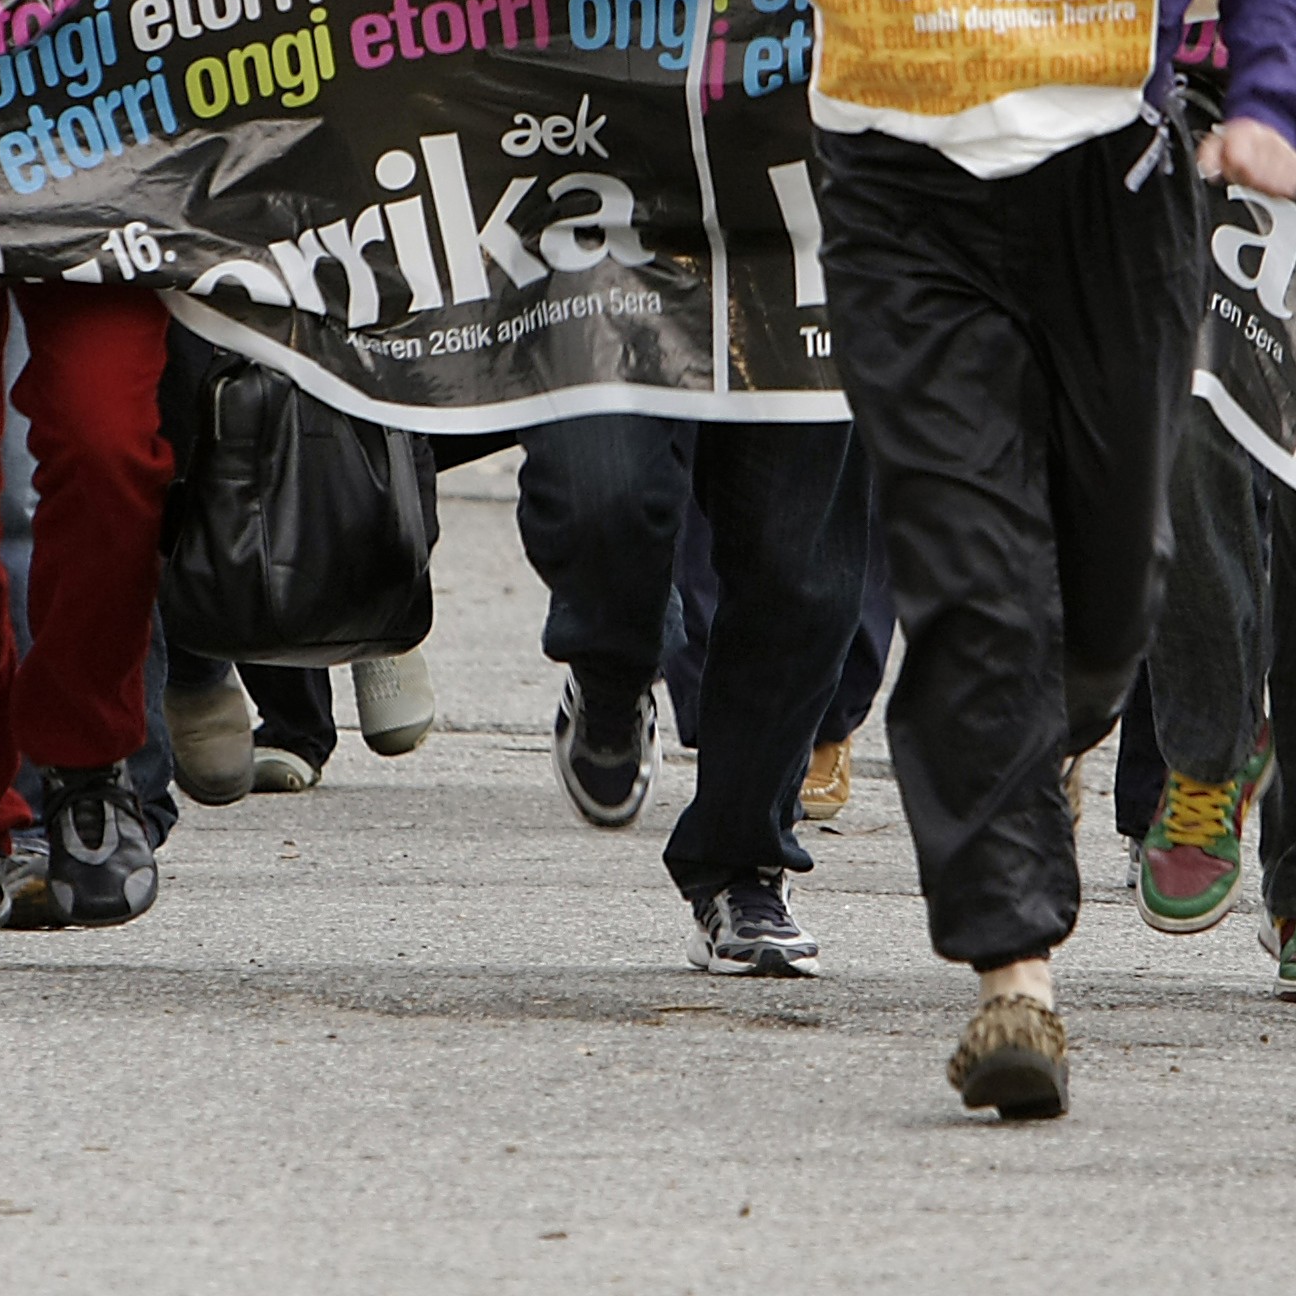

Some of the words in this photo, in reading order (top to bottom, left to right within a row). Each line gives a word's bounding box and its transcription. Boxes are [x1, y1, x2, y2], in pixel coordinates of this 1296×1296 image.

[914, 7, 957, 32] nahi
[965, 5, 1056, 34] dugunon
[1063, 1, 1136, 26] herrira
[184, 7, 335, 119] ongi
[501, 93, 609, 160] aek
[101, 221, 177, 280] 16.
[187, 132, 656, 328] rrika
[428, 323, 493, 357] 26tik
[497, 292, 602, 345] apirilaren
[609, 287, 662, 315] 5era
[1244, 314, 1283, 365] 5era
